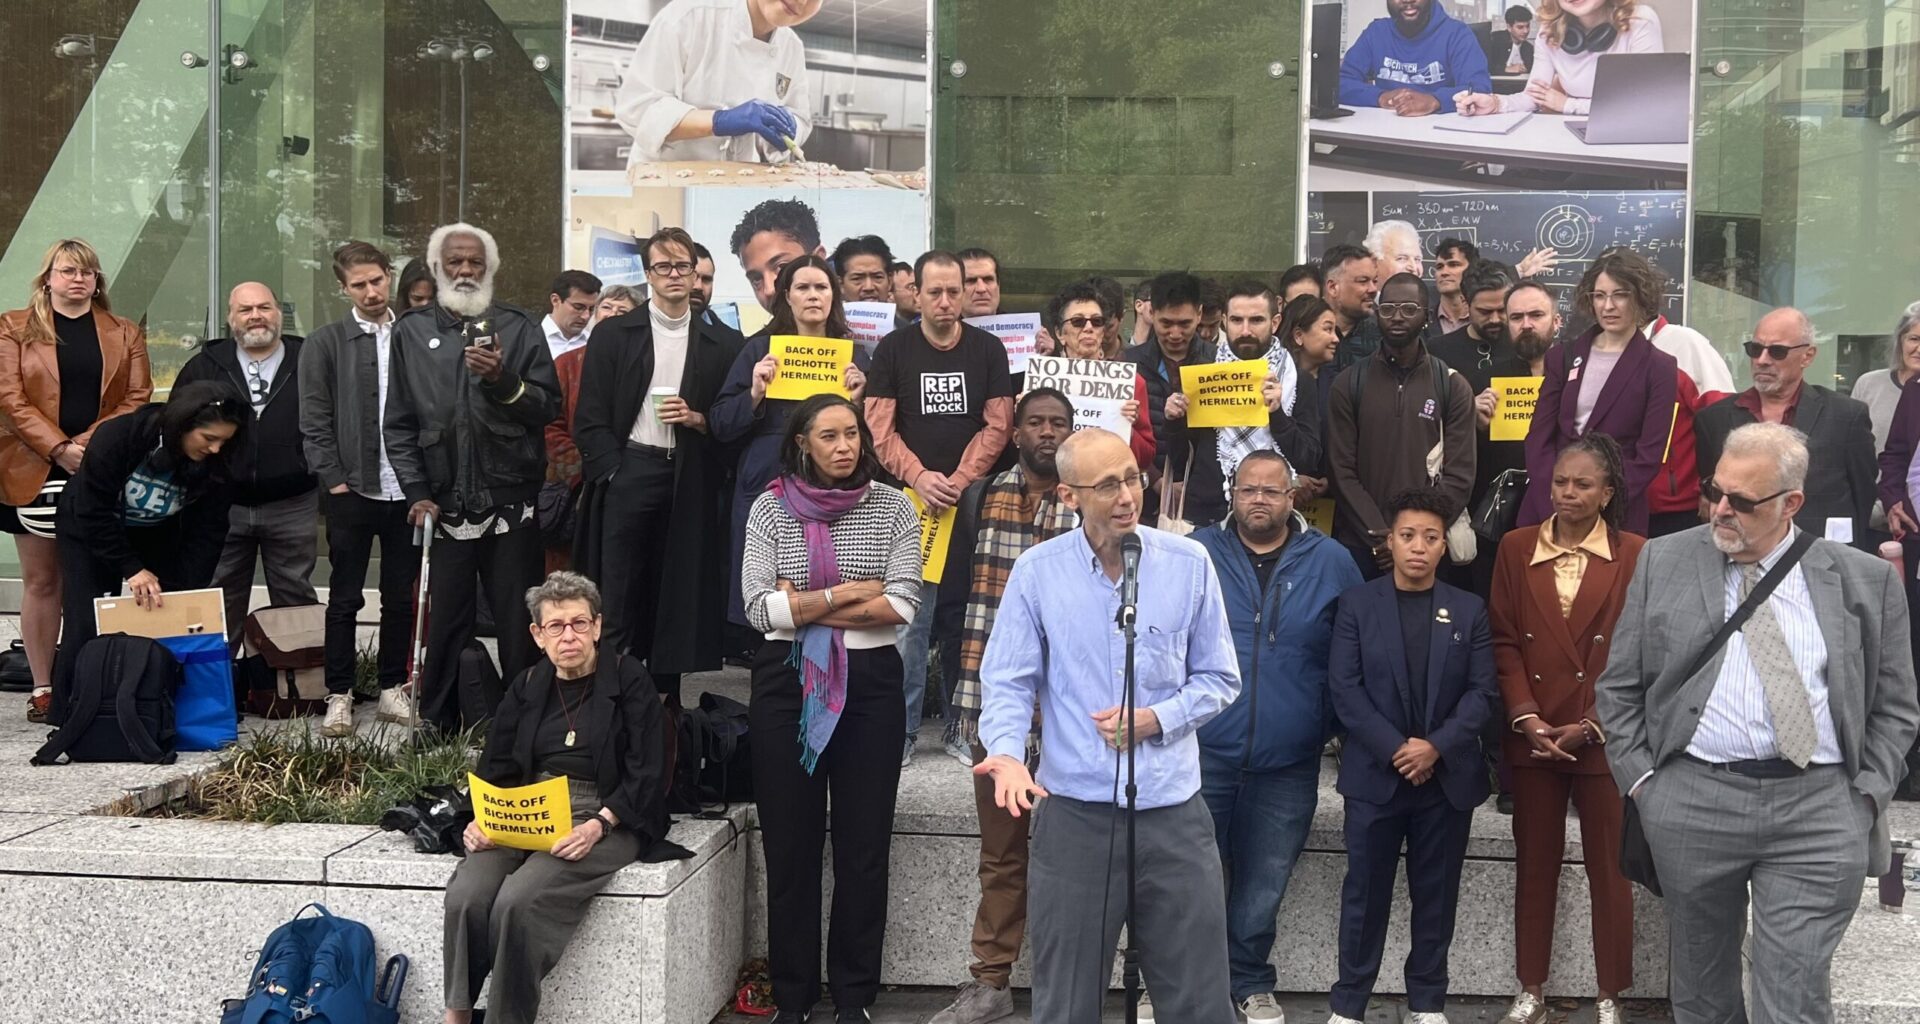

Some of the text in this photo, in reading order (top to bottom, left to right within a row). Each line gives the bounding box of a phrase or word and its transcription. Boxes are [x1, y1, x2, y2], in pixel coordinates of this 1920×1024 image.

[853, 309, 888, 319] Democracy
[996, 322, 1034, 330] Democracy
[785, 346, 837, 356] BACK OFF
[784, 359, 837, 369] BICHOTTE
[1027, 358, 1135, 379] NO KINGS
[781, 371, 838, 382] HERMELYN
[1198, 372, 1252, 383] BACK OFF
[925, 376, 960, 392] REP
[1199, 384, 1254, 394] BICHOTTE
[1079, 380, 1135, 400] DEMS
[926, 392, 962, 403] YOUR
[1199, 398, 1256, 406] HERMELYN
[926, 402, 962, 413] BLOCK
[1082, 410, 1102, 418] OFF
[483, 793, 547, 808] BACK OFF
[484, 807, 550, 821] BICHOTTE
[484, 820, 555, 834] HERMELYN
